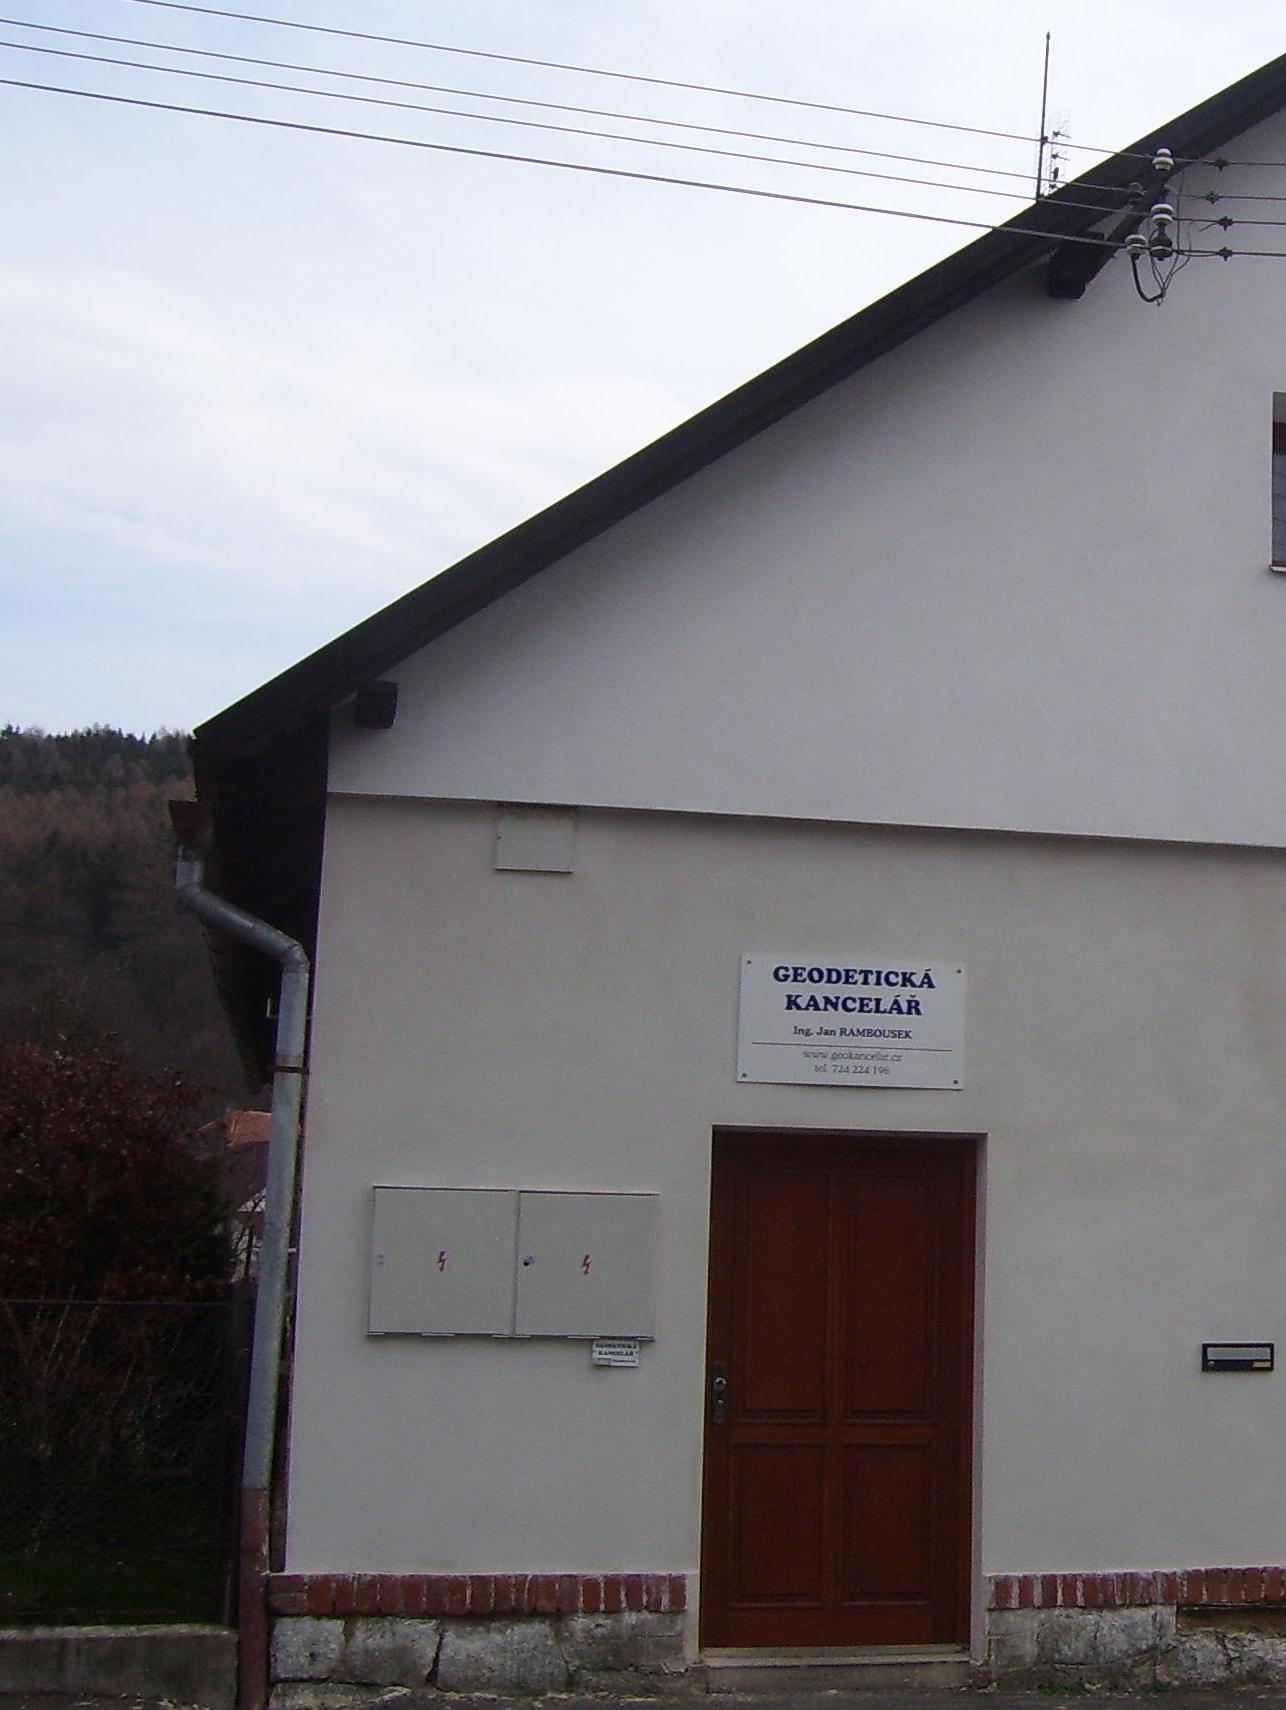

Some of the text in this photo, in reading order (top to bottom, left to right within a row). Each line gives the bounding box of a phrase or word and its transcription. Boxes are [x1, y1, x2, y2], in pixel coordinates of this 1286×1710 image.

[773, 966, 936, 989] GEODETICKÁ
[785, 993, 923, 1016] KANCELÁŘ
[793, 1025, 912, 1040] Ing. Jan RAMBOUSEK
